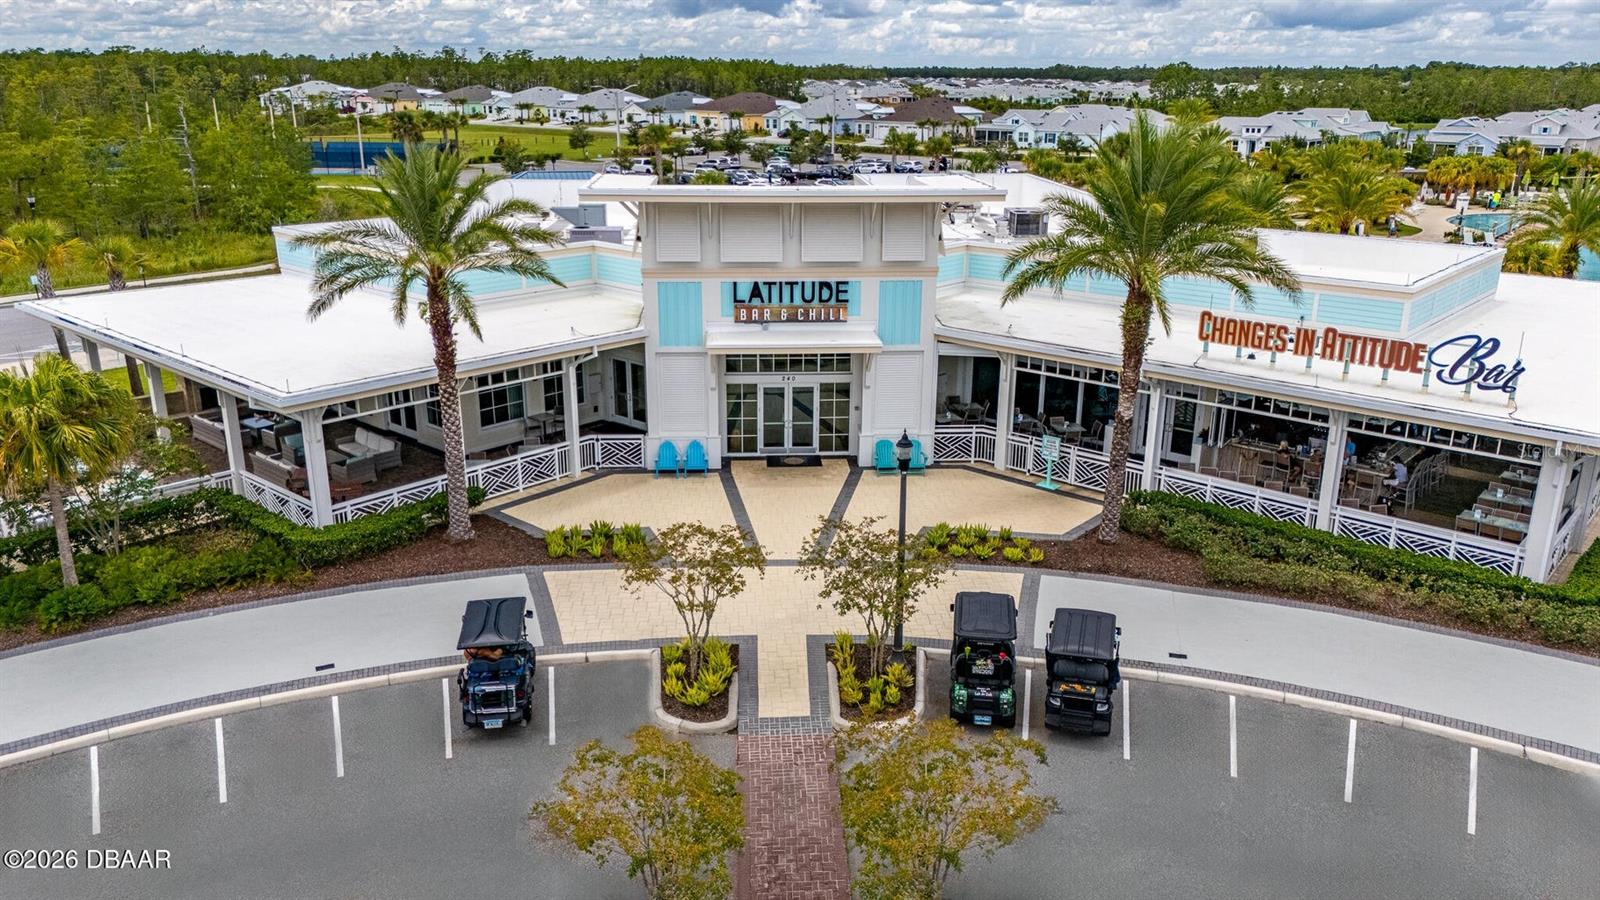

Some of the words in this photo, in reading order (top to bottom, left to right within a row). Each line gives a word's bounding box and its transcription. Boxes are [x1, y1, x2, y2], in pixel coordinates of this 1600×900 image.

[733, 281, 849, 303] LATITUDE
[740, 308, 771, 320] BAR
[781, 308, 788, 320] &
[797, 308, 844, 320] CHILL
[1199, 311, 1289, 352] CHANGES
[1294, 327, 1317, 357] IN
[1320, 327, 1428, 374] ATTITUDE
[1429, 334, 1526, 393] Bar
